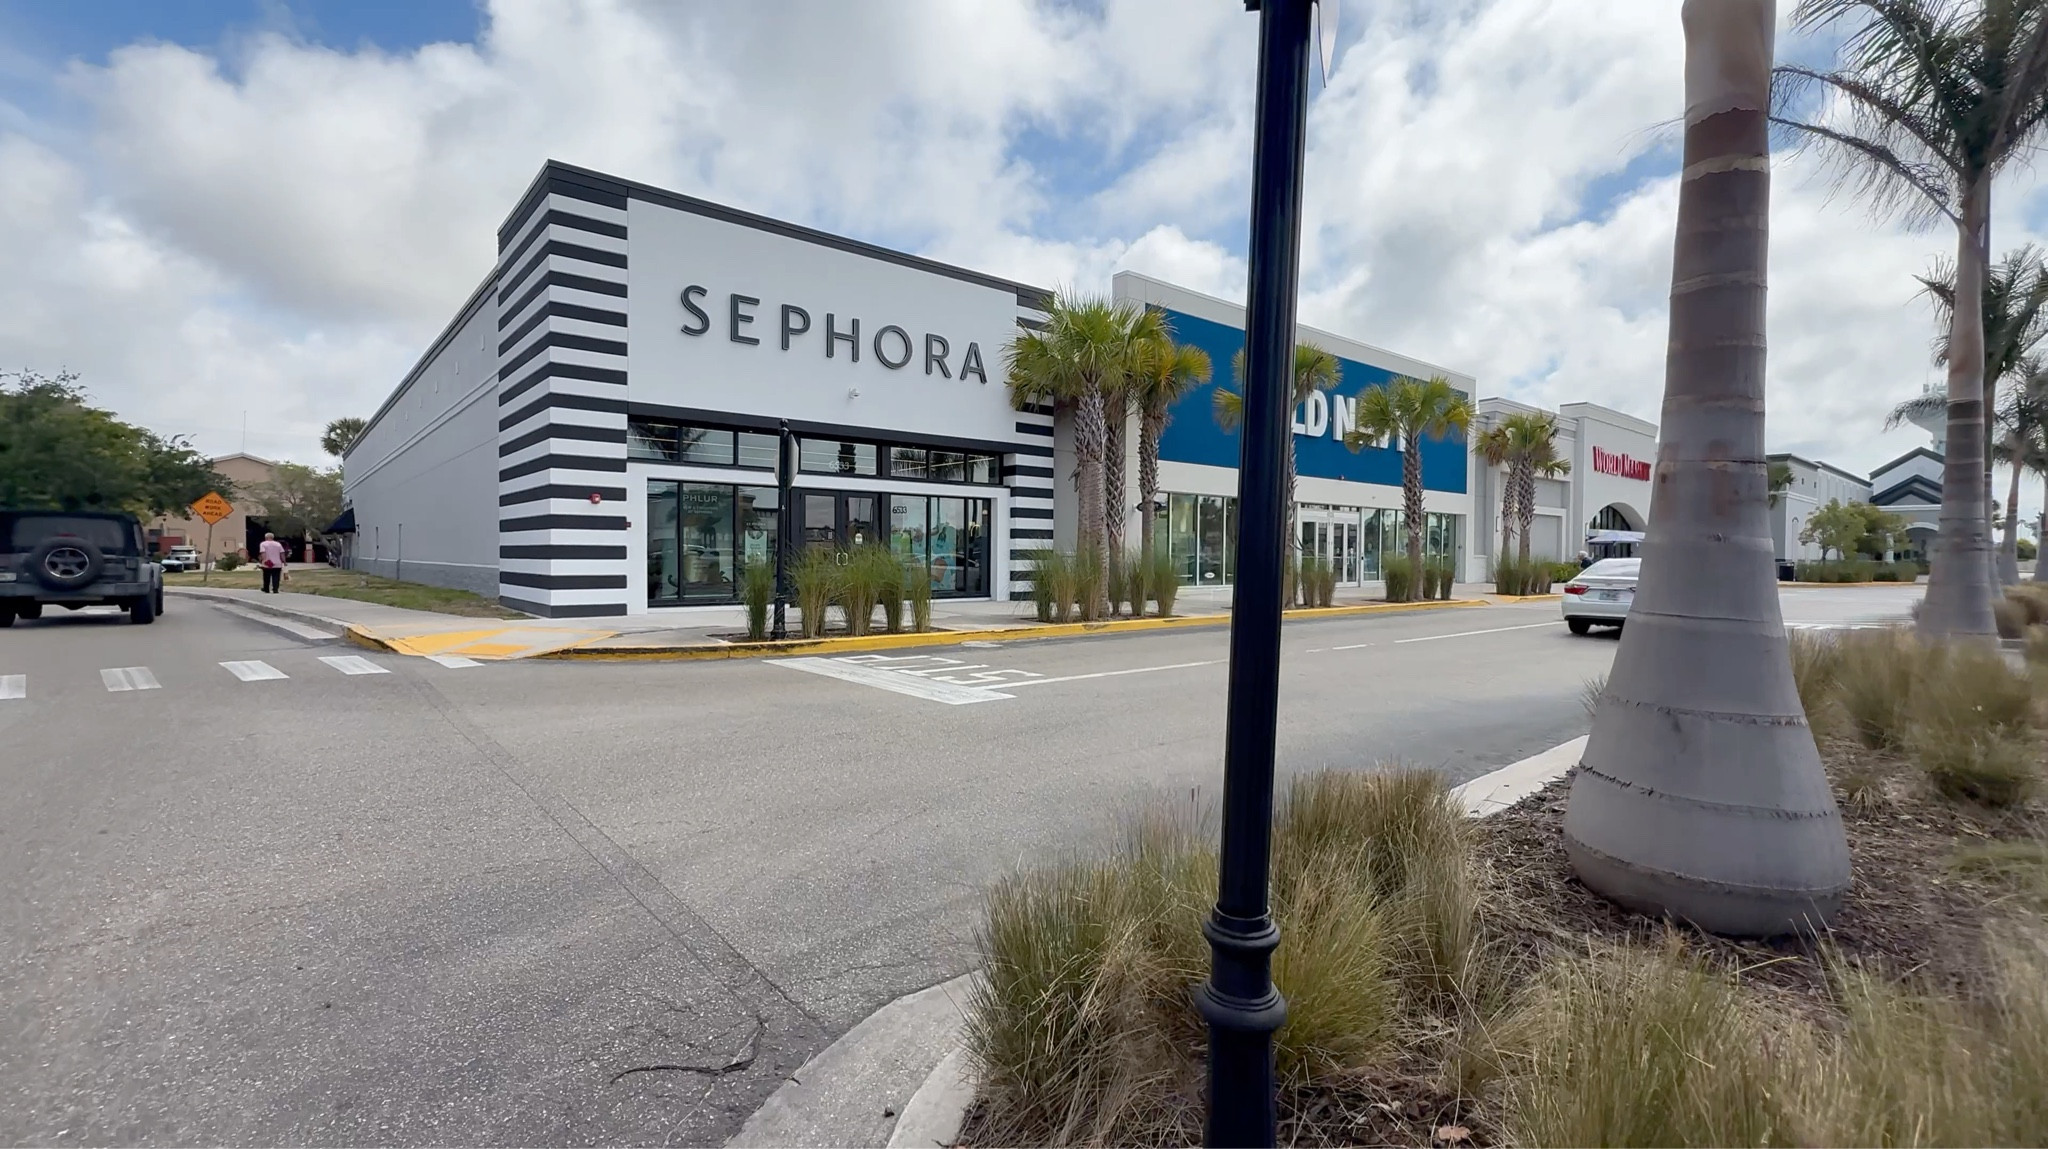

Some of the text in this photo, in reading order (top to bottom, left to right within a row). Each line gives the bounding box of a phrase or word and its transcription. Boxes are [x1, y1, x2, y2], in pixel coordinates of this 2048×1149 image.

[680, 285, 988, 384] SEPHORA
[1292, 388, 1328, 438] LD
[829, 460, 850, 470] 6533
[1593, 445, 1622, 475] WORLD
[683, 494, 718, 503] PHLUR
[892, 506, 908, 514] 6533
